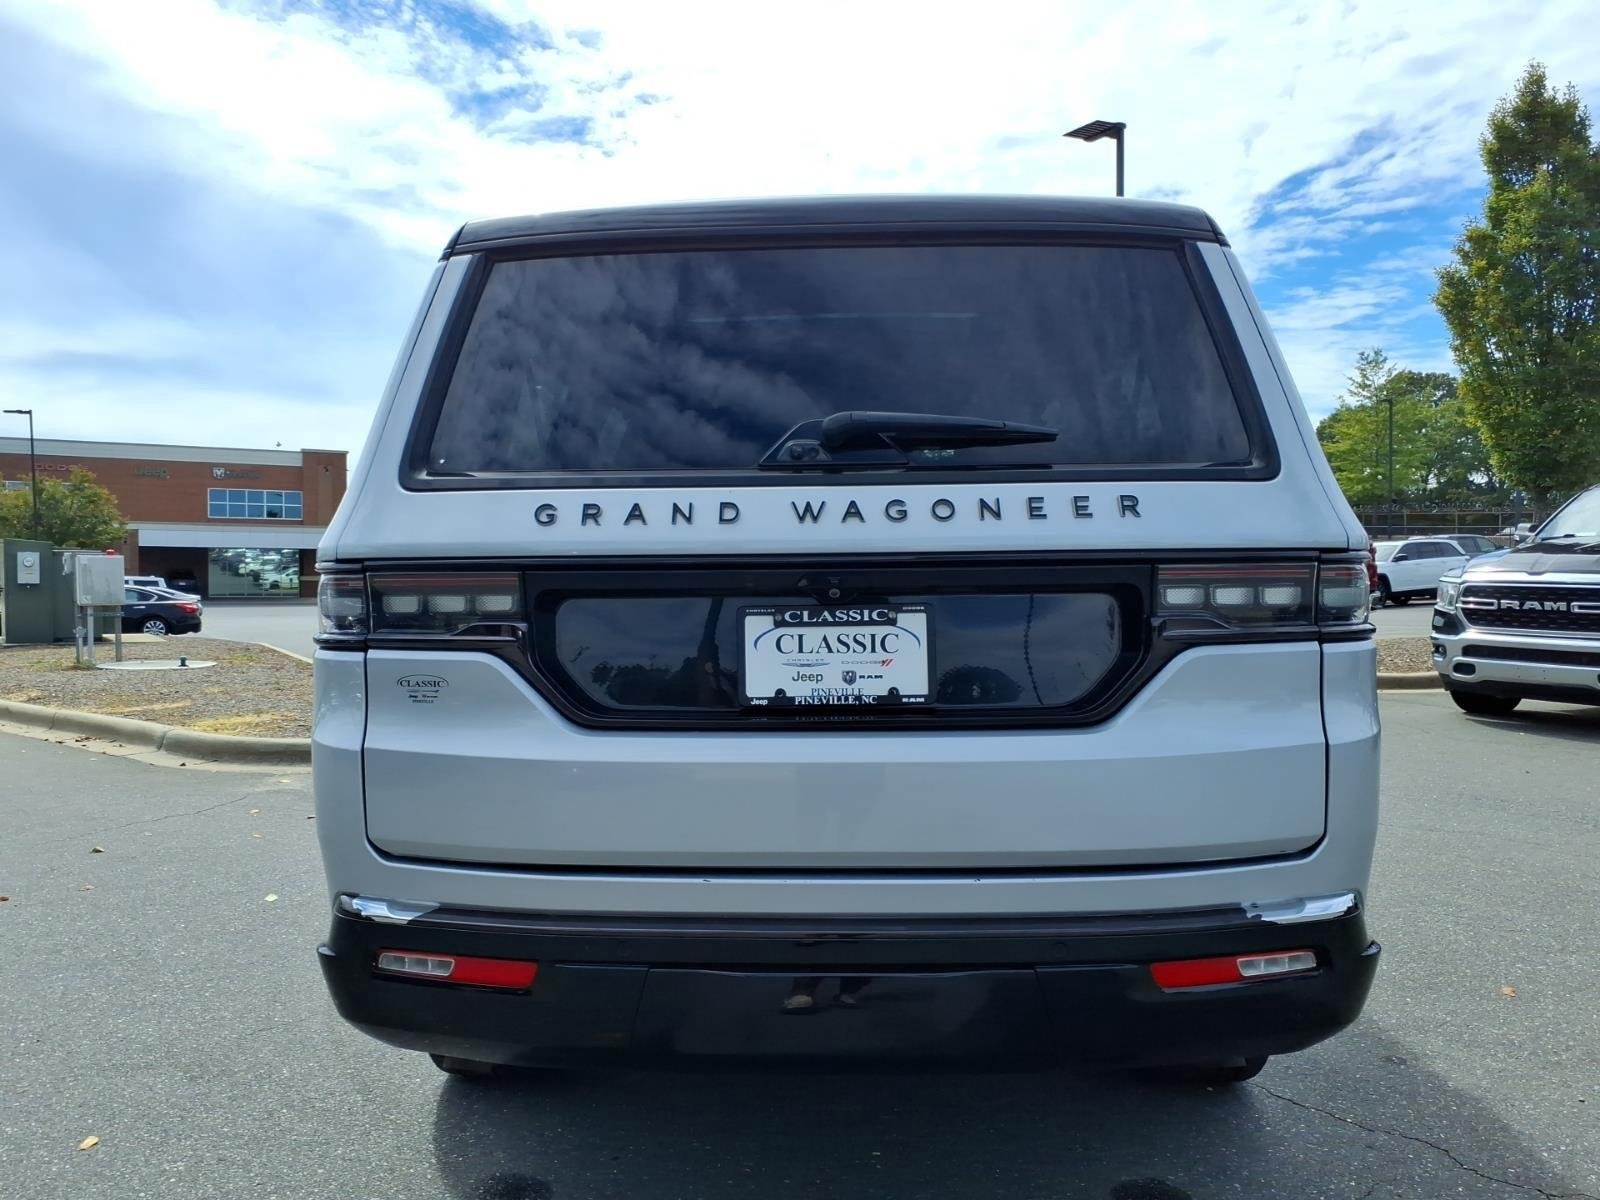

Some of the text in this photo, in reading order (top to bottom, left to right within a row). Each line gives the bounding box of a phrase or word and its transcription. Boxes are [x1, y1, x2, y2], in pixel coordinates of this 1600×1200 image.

[534, 494, 1142, 527] GRAND WAGONEER
[1500, 599, 1567, 611] RAM
[784, 609, 888, 623] CLASSIC
[775, 633, 899, 654] CLASSIC
[791, 671, 824, 684] Jeep
[811, 688, 864, 696] PINEVILLE
[750, 698, 768, 706] Jeep
[795, 695, 877, 705] PINEVILLE, NC
